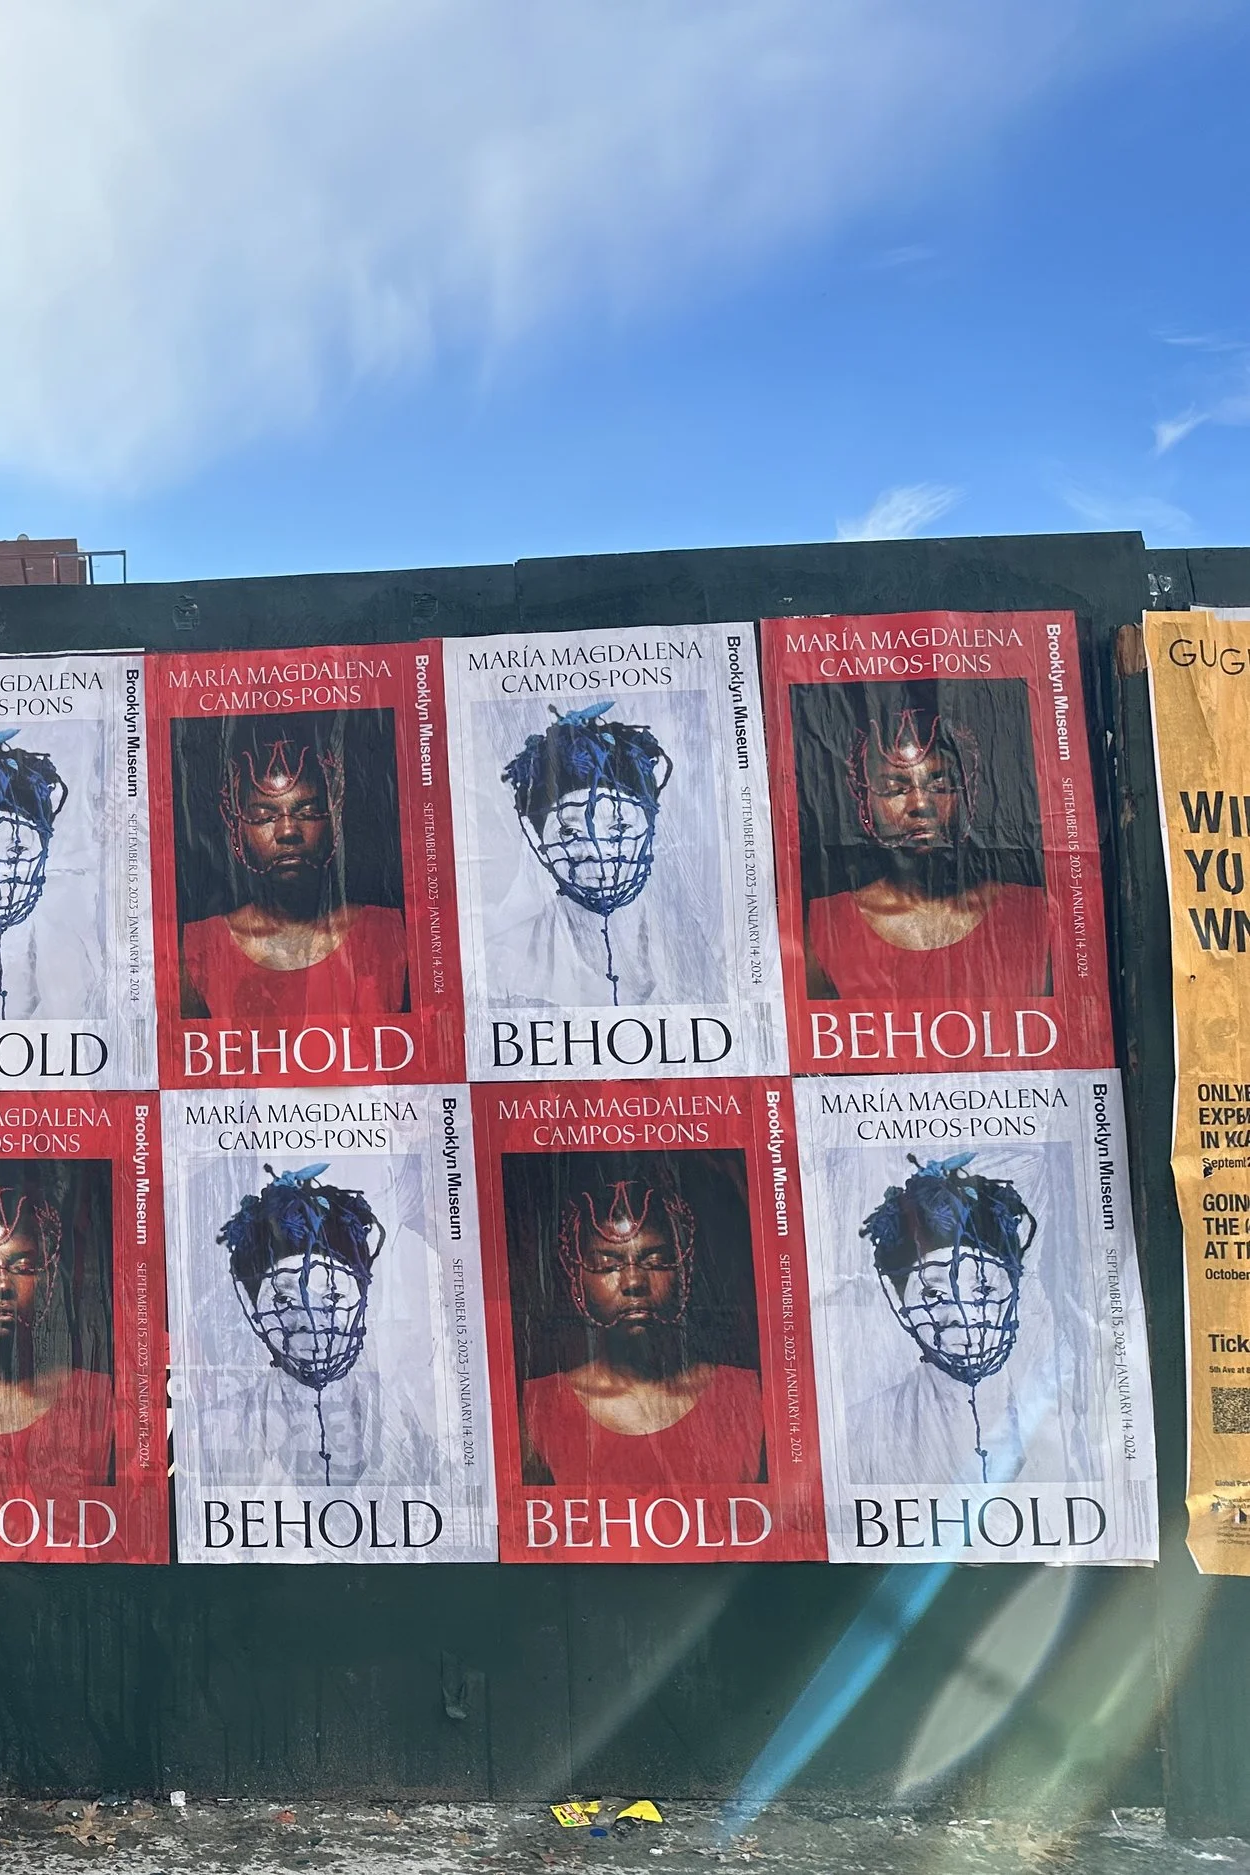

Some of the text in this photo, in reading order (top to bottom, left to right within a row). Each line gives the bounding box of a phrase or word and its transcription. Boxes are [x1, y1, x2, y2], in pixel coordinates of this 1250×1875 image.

[469, 640, 703, 670] MARÍA MAGDALENA
[786, 627, 1023, 652] MARÍA MAGDALENA
[821, 653, 992, 676] CAMPOS-PONS
[1169, 638, 1250, 676] GUG
[169, 659, 392, 688] MARÍA MAGDALENA
[199, 685, 361, 711] CAMPOS-PONS
[501, 665, 671, 693] CAMPOS-PONS
[1046, 624, 1070, 760] Brooklyn Museum
[414, 654, 433, 786] Brooklyn Museum
[727, 636, 748, 769] Brooklyn Museum
[123, 669, 140, 797] Brooklyn Museum
[423, 802, 436, 862] SEPTEMBER
[433, 969, 444, 994] 2024
[740, 786, 755, 847] SEPTEMBER
[750, 959, 762, 984] 2024
[1062, 777, 1078, 839] SEPTEMBER
[1076, 952, 1089, 978] 2024
[183, 1026, 414, 1076] BEHOLD
[491, 1016, 734, 1067] BEHOLD
[811, 1008, 1058, 1061] BEHOLD
[185, 1099, 418, 1125] MARÍA MAGDALENA
[498, 1093, 741, 1119] MARÍA MAGDALENA
[822, 1087, 1067, 1114] MARÍA MAGDALENA
[218, 1127, 386, 1150] CAMPOS-PONS
[532, 1122, 709, 1146] CAMPOS-PONS
[858, 1114, 1035, 1140] CAMPOS-PONS
[132, 1105, 149, 1244] Brooklyn Museum
[442, 1098, 462, 1240] Brooklyn Museum
[766, 1091, 788, 1236] Brooklyn Museum
[1092, 1084, 1115, 1230] Brooklyn Museum
[1202, 1217, 1240, 1236] THE
[1204, 1241, 1229, 1259] AT
[452, 1258, 466, 1322] SEPTEMBER
[463, 1440, 475, 1466] 2024
[779, 1254, 794, 1319] SEPTEMBER
[790, 1437, 803, 1463] 2024
[1106, 1248, 1121, 1314] SEPTEMBER
[1123, 1433, 1136, 1460] 2024
[203, 1499, 443, 1549] BEHOLD
[525, 1496, 773, 1548] BEHOLD
[857, 1496, 1106, 1549] BEHOLD
